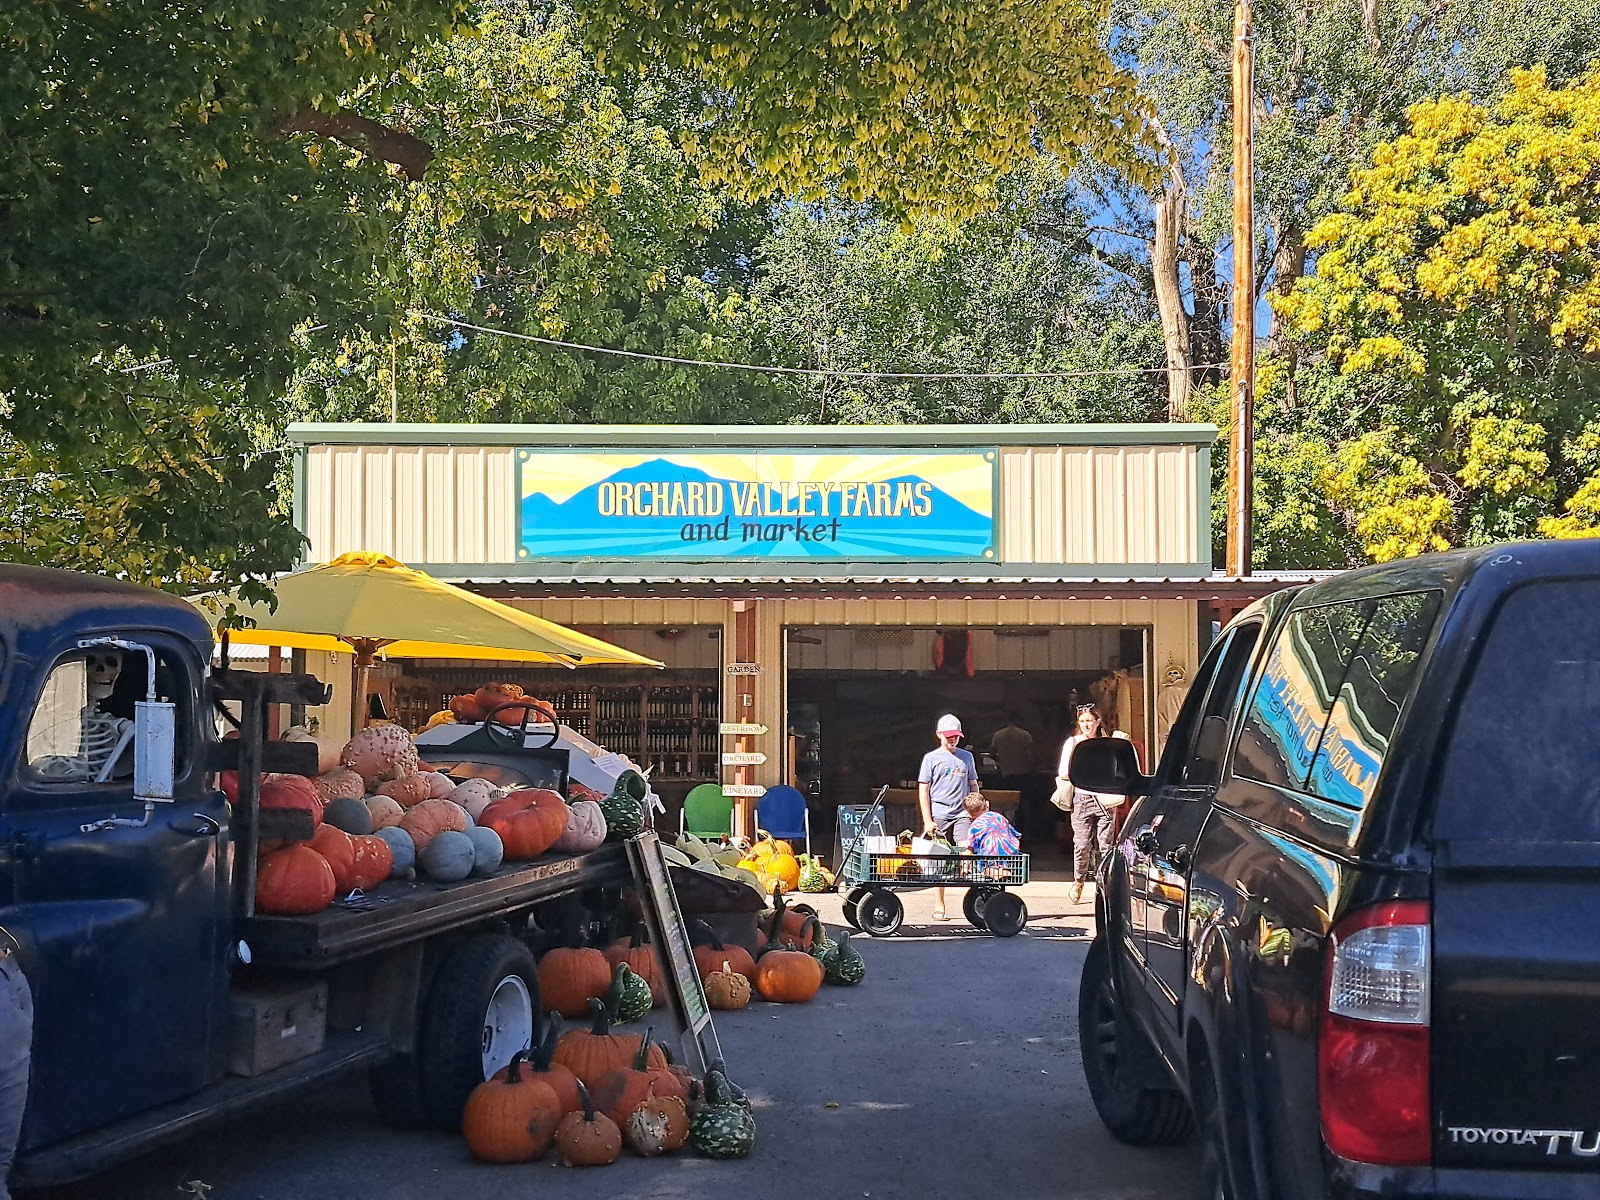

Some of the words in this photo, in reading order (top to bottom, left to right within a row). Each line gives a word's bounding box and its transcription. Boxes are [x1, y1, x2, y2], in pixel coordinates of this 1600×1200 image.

[597, 481, 724, 517] ORCHARD
[728, 481, 835, 517] VALLEY
[839, 481, 933, 517] FARMS
[680, 515, 731, 542] and
[740, 516, 843, 543] market
[721, 725, 763, 733] RESTROOM
[723, 787, 765, 795] VINEYARD
[1447, 1127, 1537, 1145] TOYOTA
